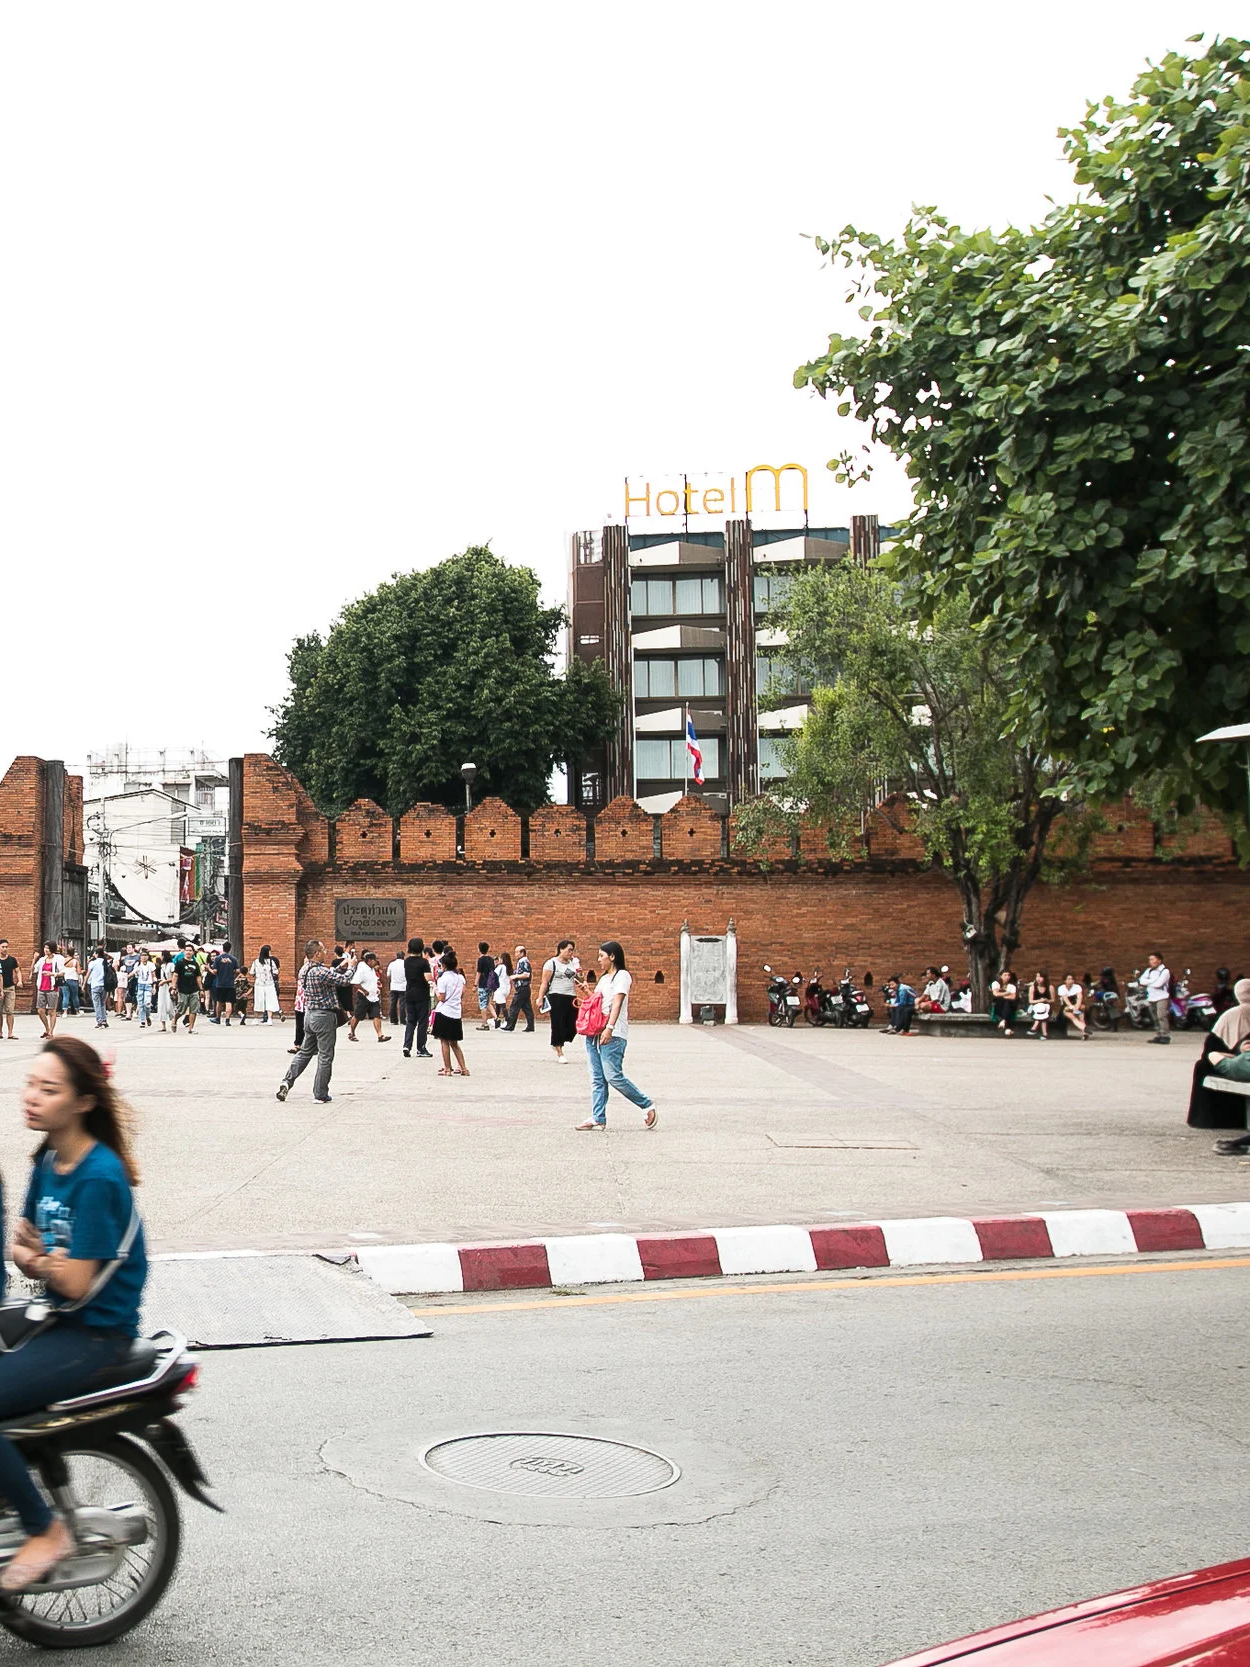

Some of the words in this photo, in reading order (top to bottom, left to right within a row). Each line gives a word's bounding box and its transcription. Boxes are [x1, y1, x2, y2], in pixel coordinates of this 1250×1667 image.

[624, 478, 736, 517] Hotel
[343, 904, 397, 918] ประตูท่าแพ
